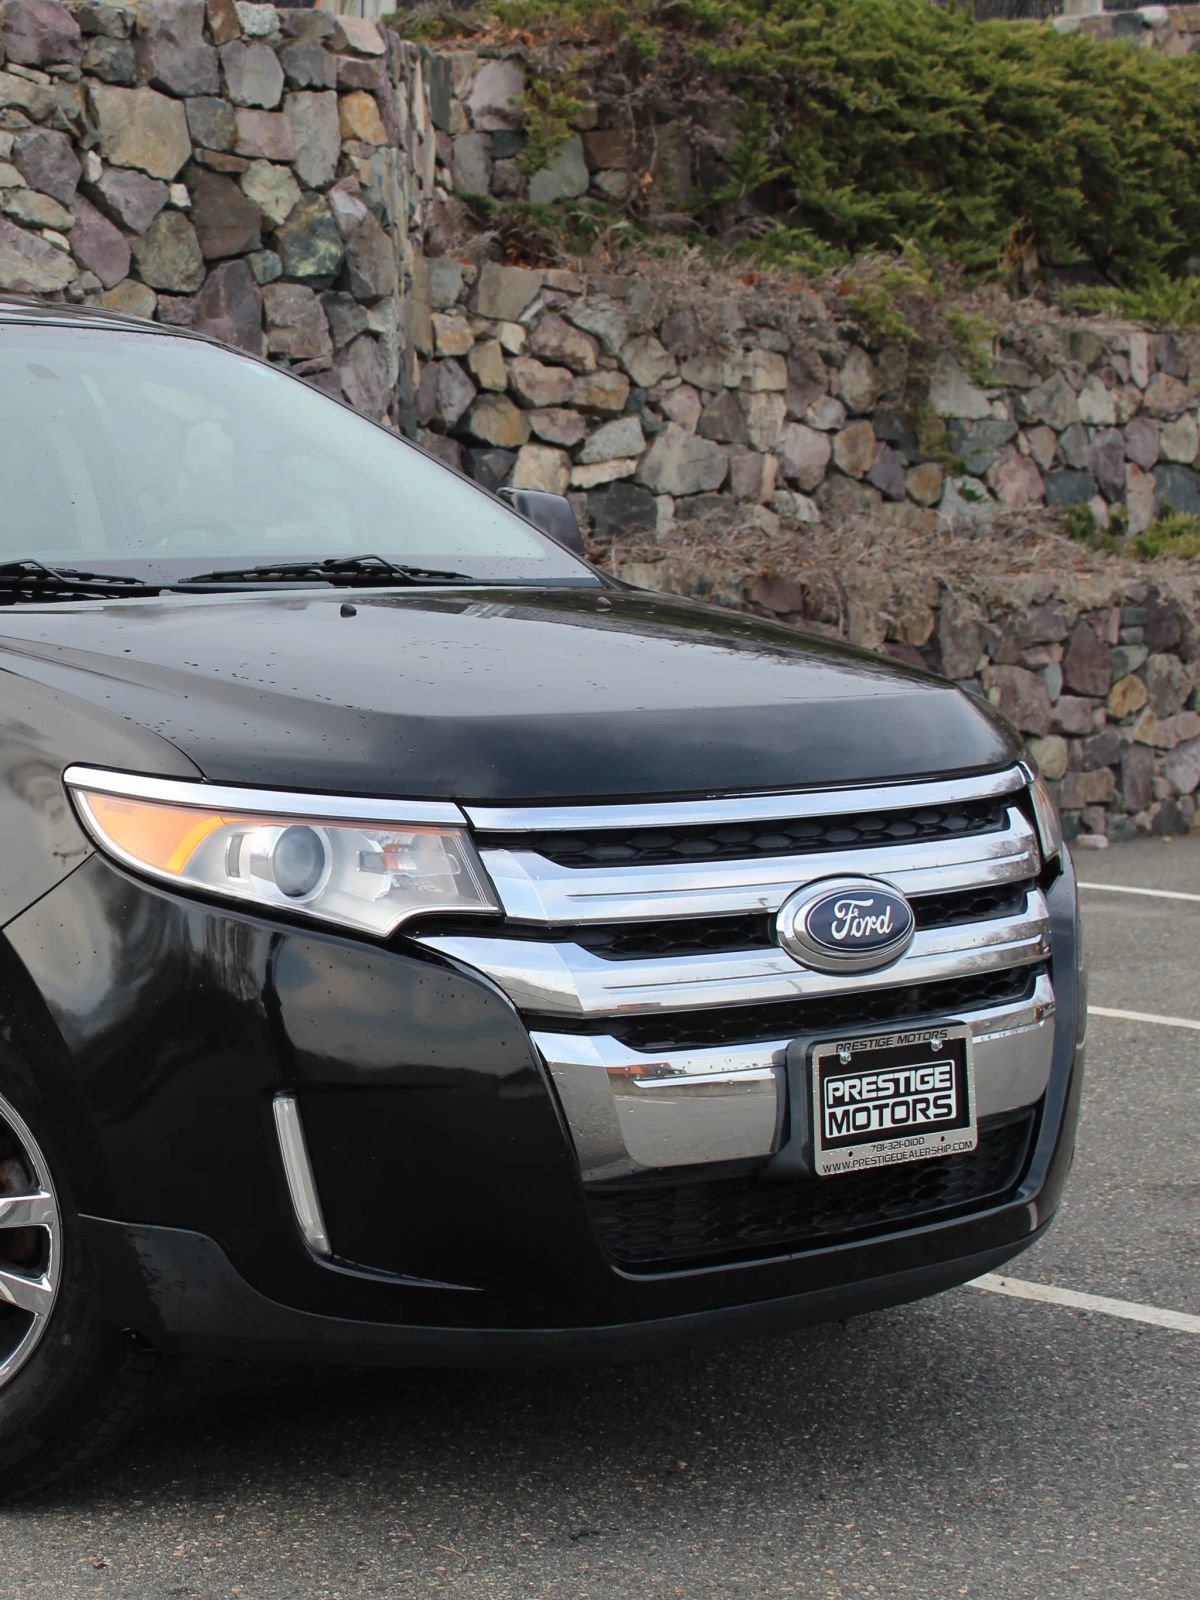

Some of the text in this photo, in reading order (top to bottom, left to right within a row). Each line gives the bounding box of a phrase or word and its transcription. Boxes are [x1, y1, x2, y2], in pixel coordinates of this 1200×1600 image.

[831, 898, 893, 940] Ford
[836, 1029, 948, 1053] PRESTIGE MOTORS
[828, 1066, 951, 1105] PRESTIGE
[828, 1094, 953, 1136] MOTORS
[822, 1140, 973, 1173] WWW.PRESTIGEDEALERSHIP.COM
[870, 1137, 925, 1153] 781-321-0100
